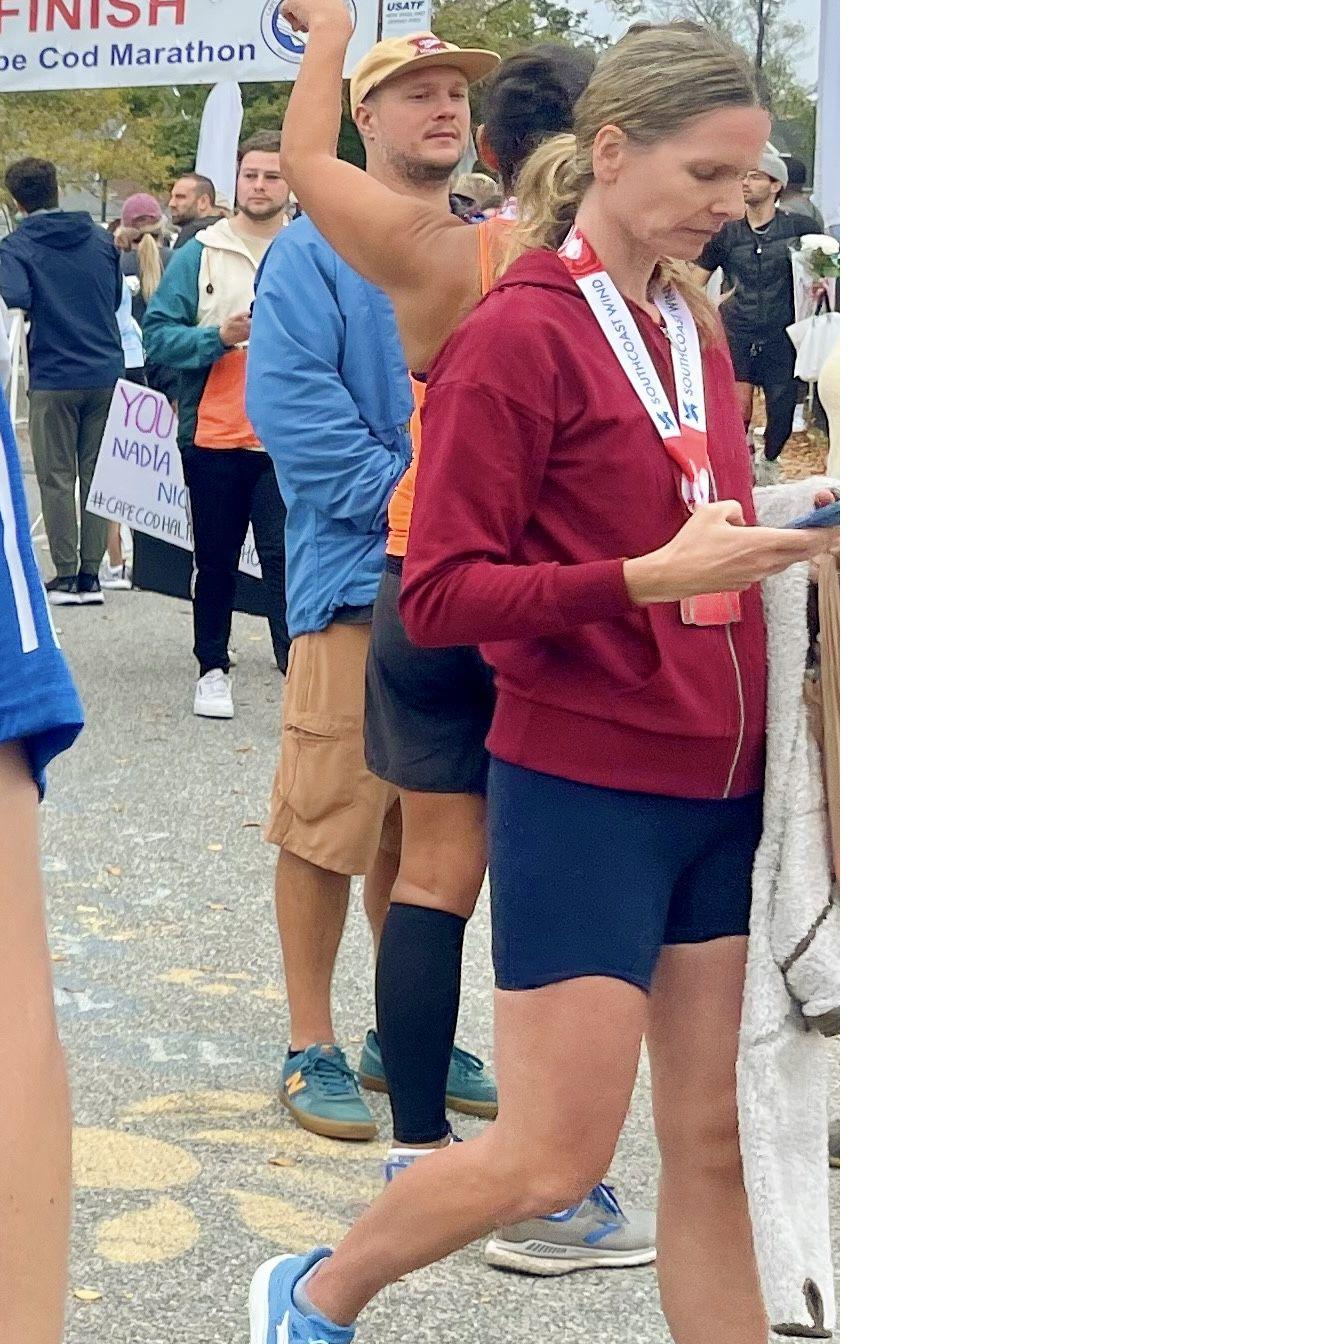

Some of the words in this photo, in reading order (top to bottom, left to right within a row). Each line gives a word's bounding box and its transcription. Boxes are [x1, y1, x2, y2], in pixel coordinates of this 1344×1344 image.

[387, 0, 425, 12] USATF
[39, 45, 99, 69] Cod
[110, 40, 256, 67] Marathon
[592, 278, 617, 316] WIND
[611, 318, 661, 405] SOUTHCOAST
[120, 386, 174, 439] YOU
[112, 437, 171, 476] NADIA
